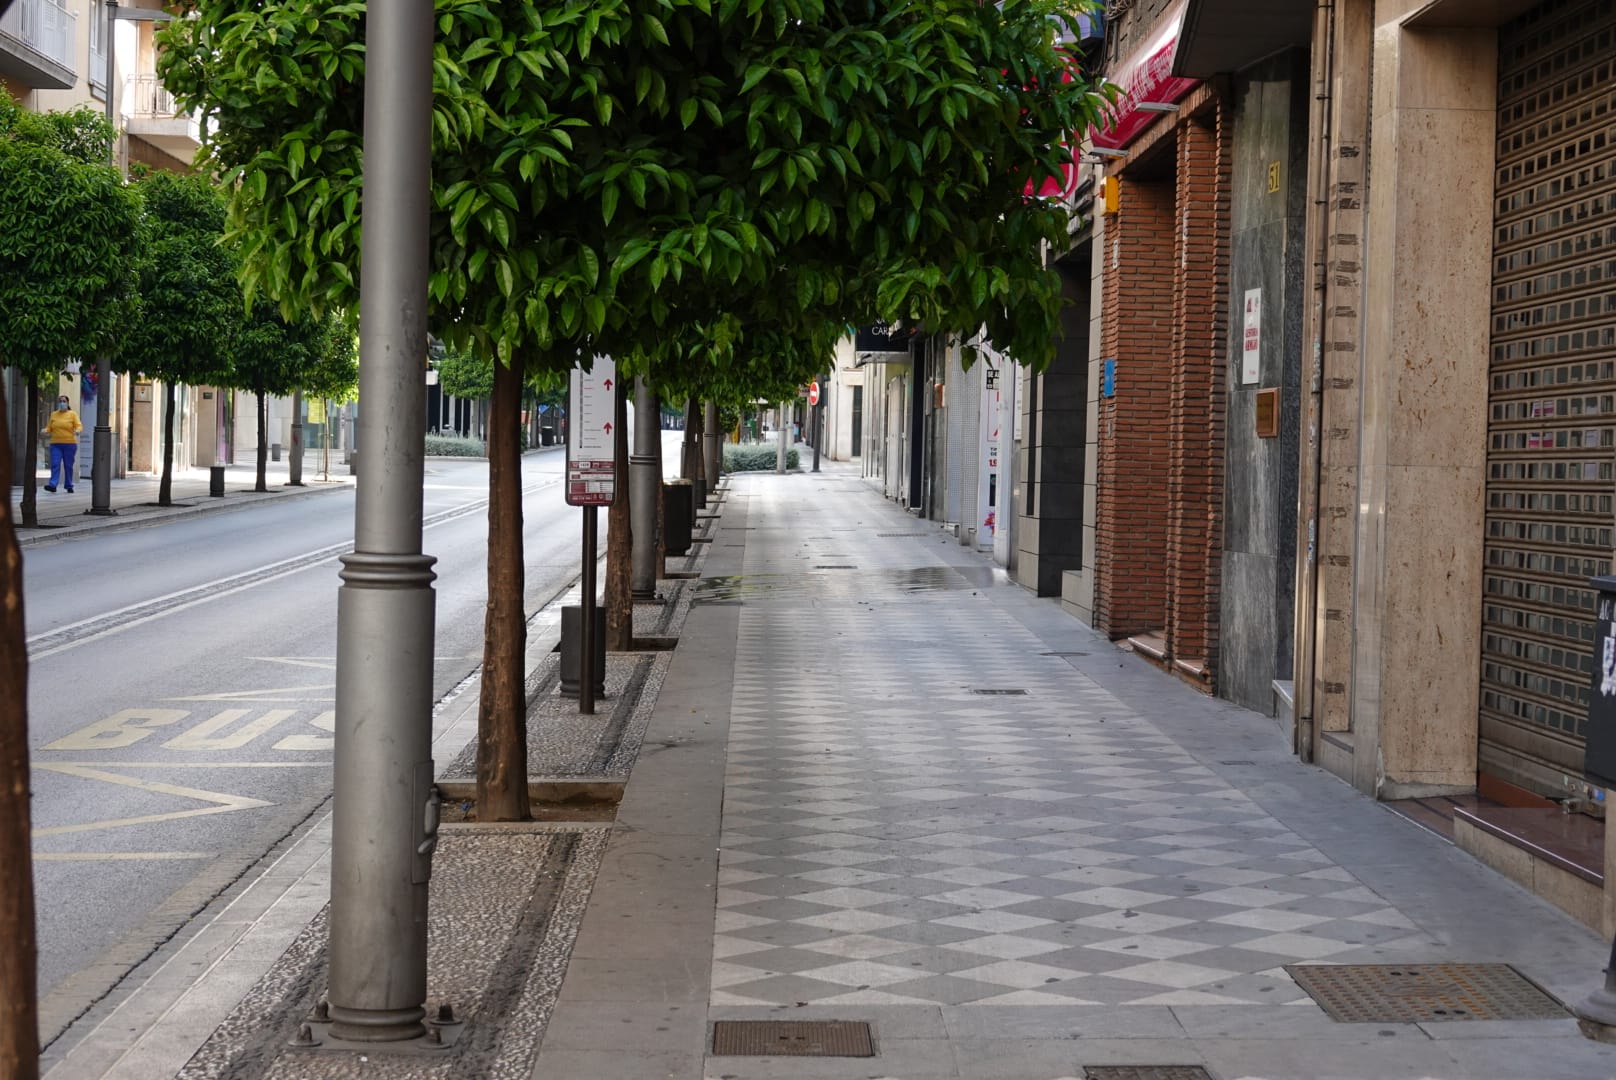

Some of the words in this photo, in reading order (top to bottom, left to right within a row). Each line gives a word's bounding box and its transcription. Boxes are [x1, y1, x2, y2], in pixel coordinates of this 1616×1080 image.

[1269, 165, 1279, 190] 51
[871, 326, 890, 336] CAR
[39, 708, 335, 750] BUS
